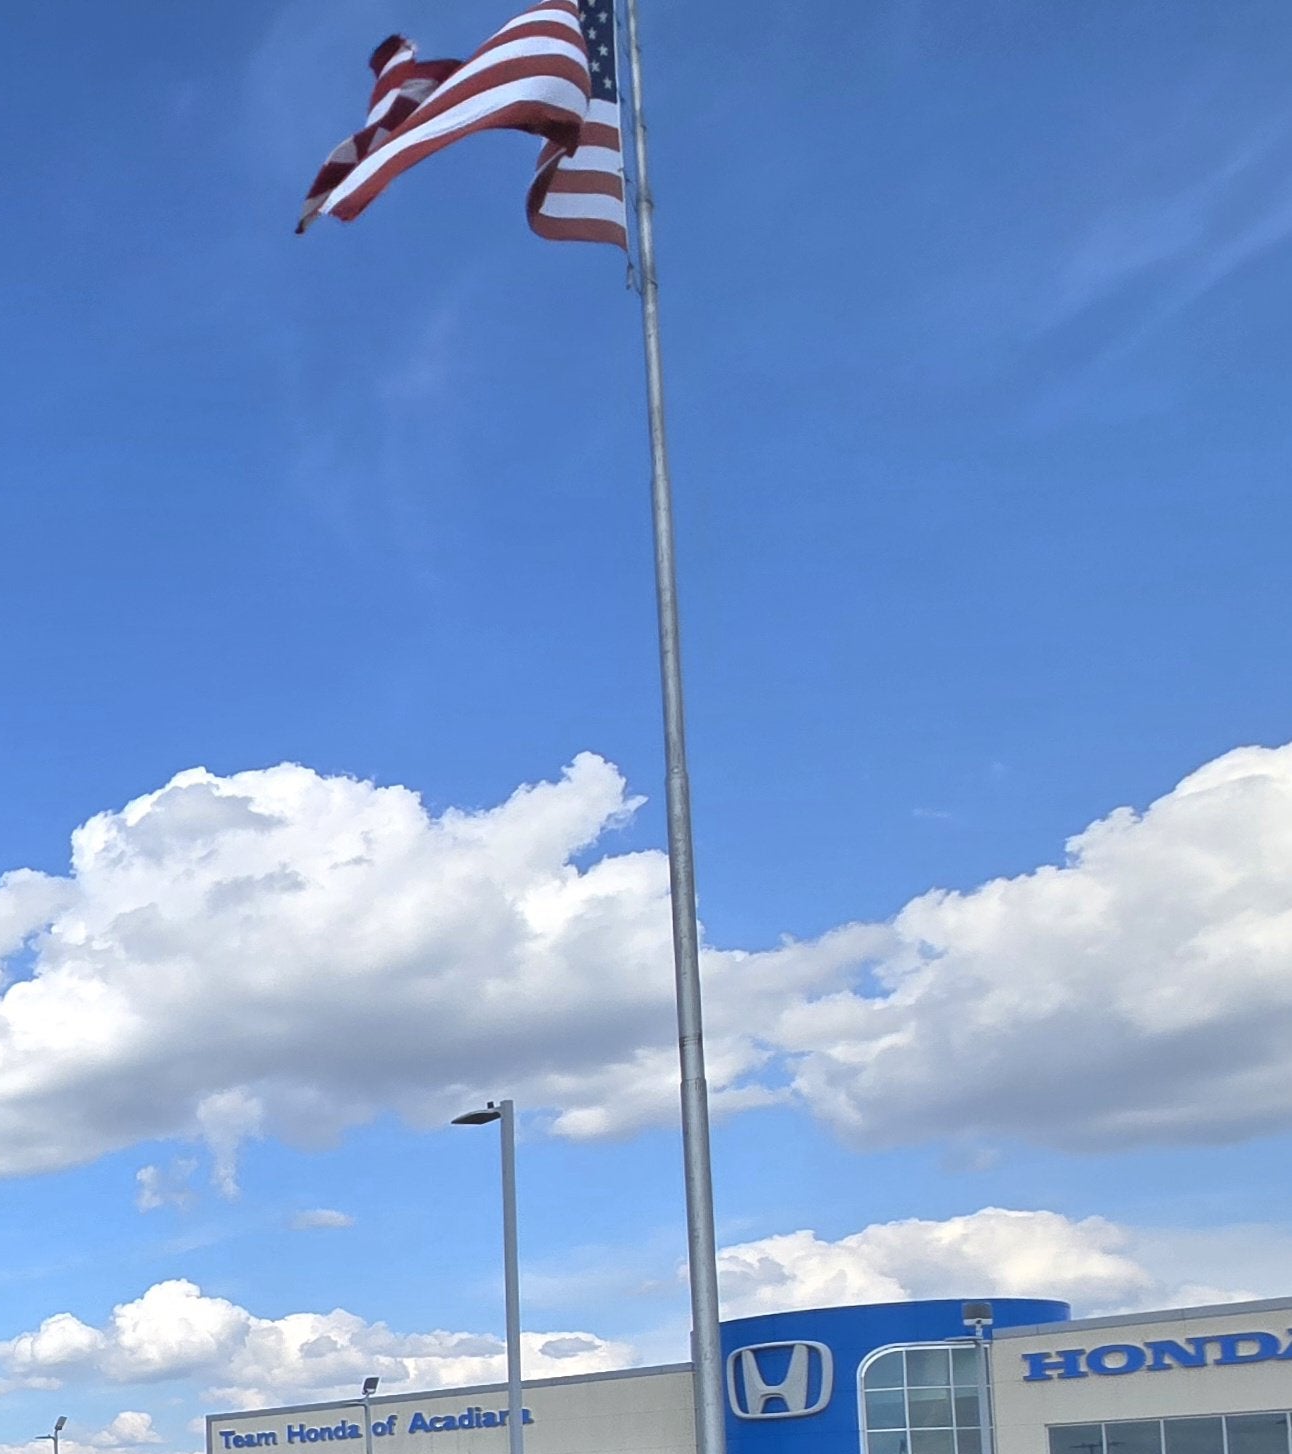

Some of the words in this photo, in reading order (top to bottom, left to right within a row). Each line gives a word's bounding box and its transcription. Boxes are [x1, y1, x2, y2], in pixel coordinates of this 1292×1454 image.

[1021, 1328, 1292, 1381] HOND
[219, 1430, 278, 1449] Team
[287, 1420, 363, 1444] Honda
[372, 1415, 398, 1437] of
